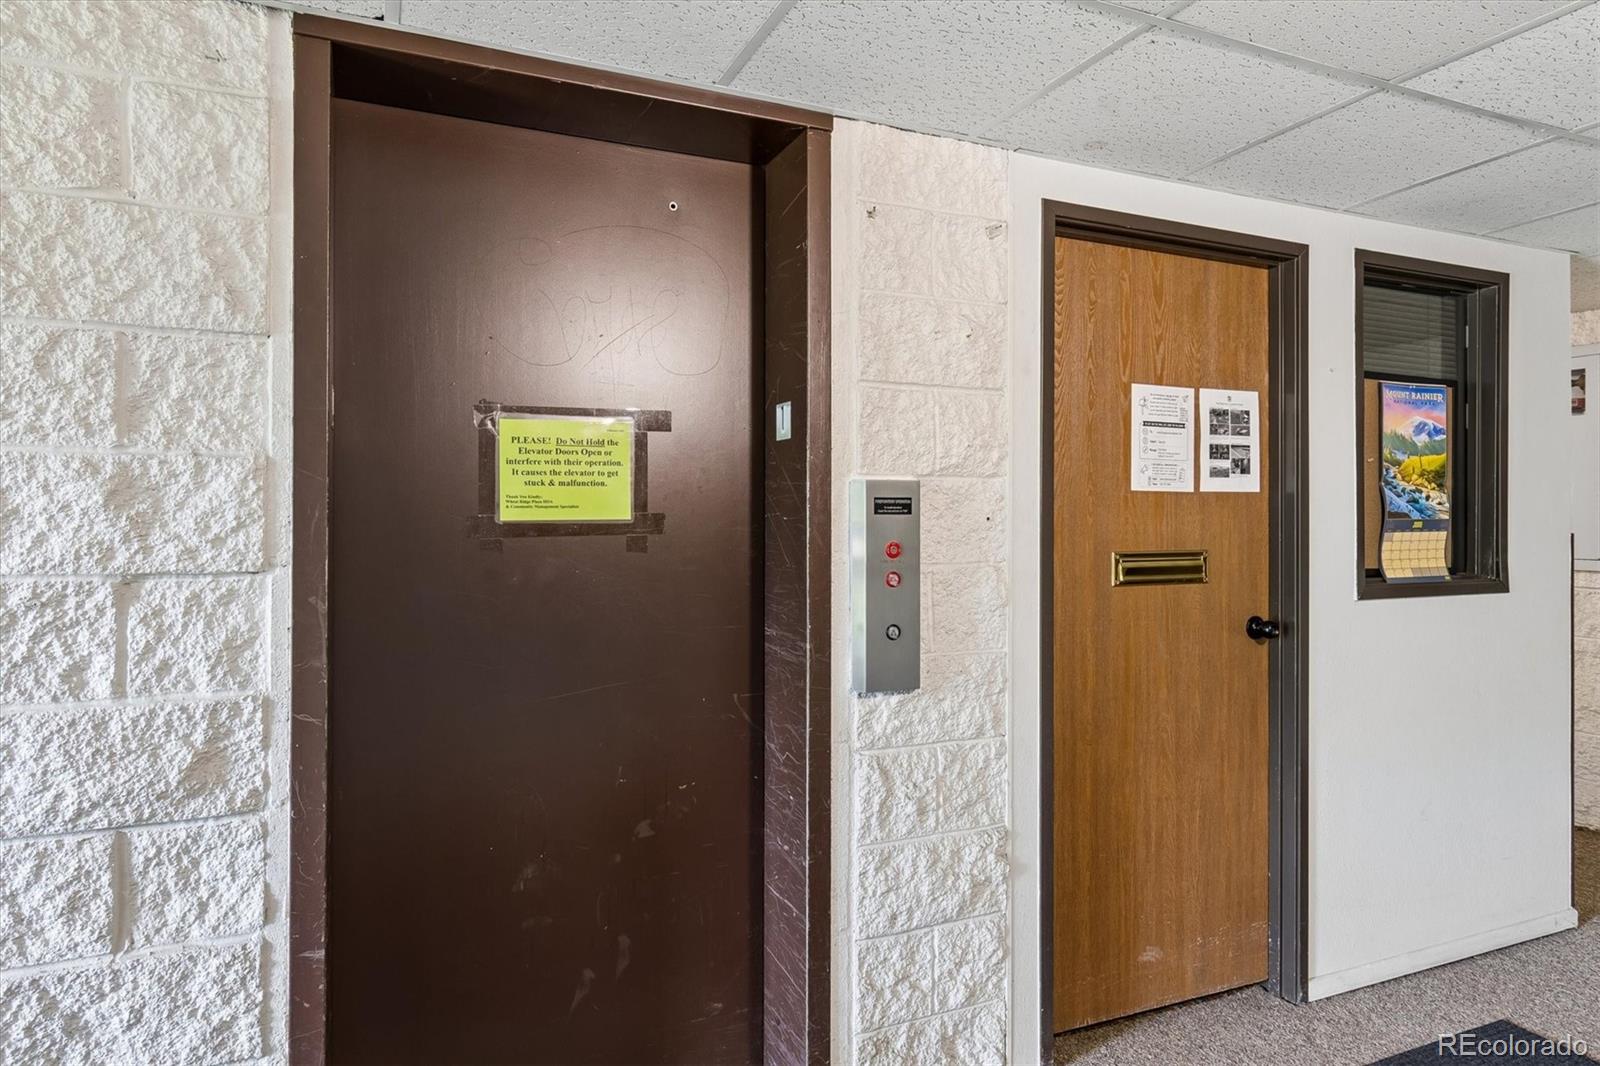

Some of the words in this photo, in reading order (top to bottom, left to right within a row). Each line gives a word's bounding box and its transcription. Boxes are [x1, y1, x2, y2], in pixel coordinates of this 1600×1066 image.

[1385, 390, 1410, 400] MOUNT
[1411, 391, 1444, 402] RAINIER
[511, 436, 552, 445] PLEASE!
[555, 437, 568, 446] Do
[570, 438, 584, 446] Not
[586, 438, 606, 447] Hold
[518, 447, 553, 455] Elevator
[555, 447, 579, 456] Doors
[581, 448, 602, 457] Open
[505, 457, 542, 465] interfere
[563, 458, 582, 466] their
[584, 459, 624, 467] operation.
[512, 468, 519, 476] It
[607, 470, 619, 478] get
[524, 479, 546, 487] stuck
[548, 479, 556, 487] &
[558, 479, 608, 487] malfunction.
